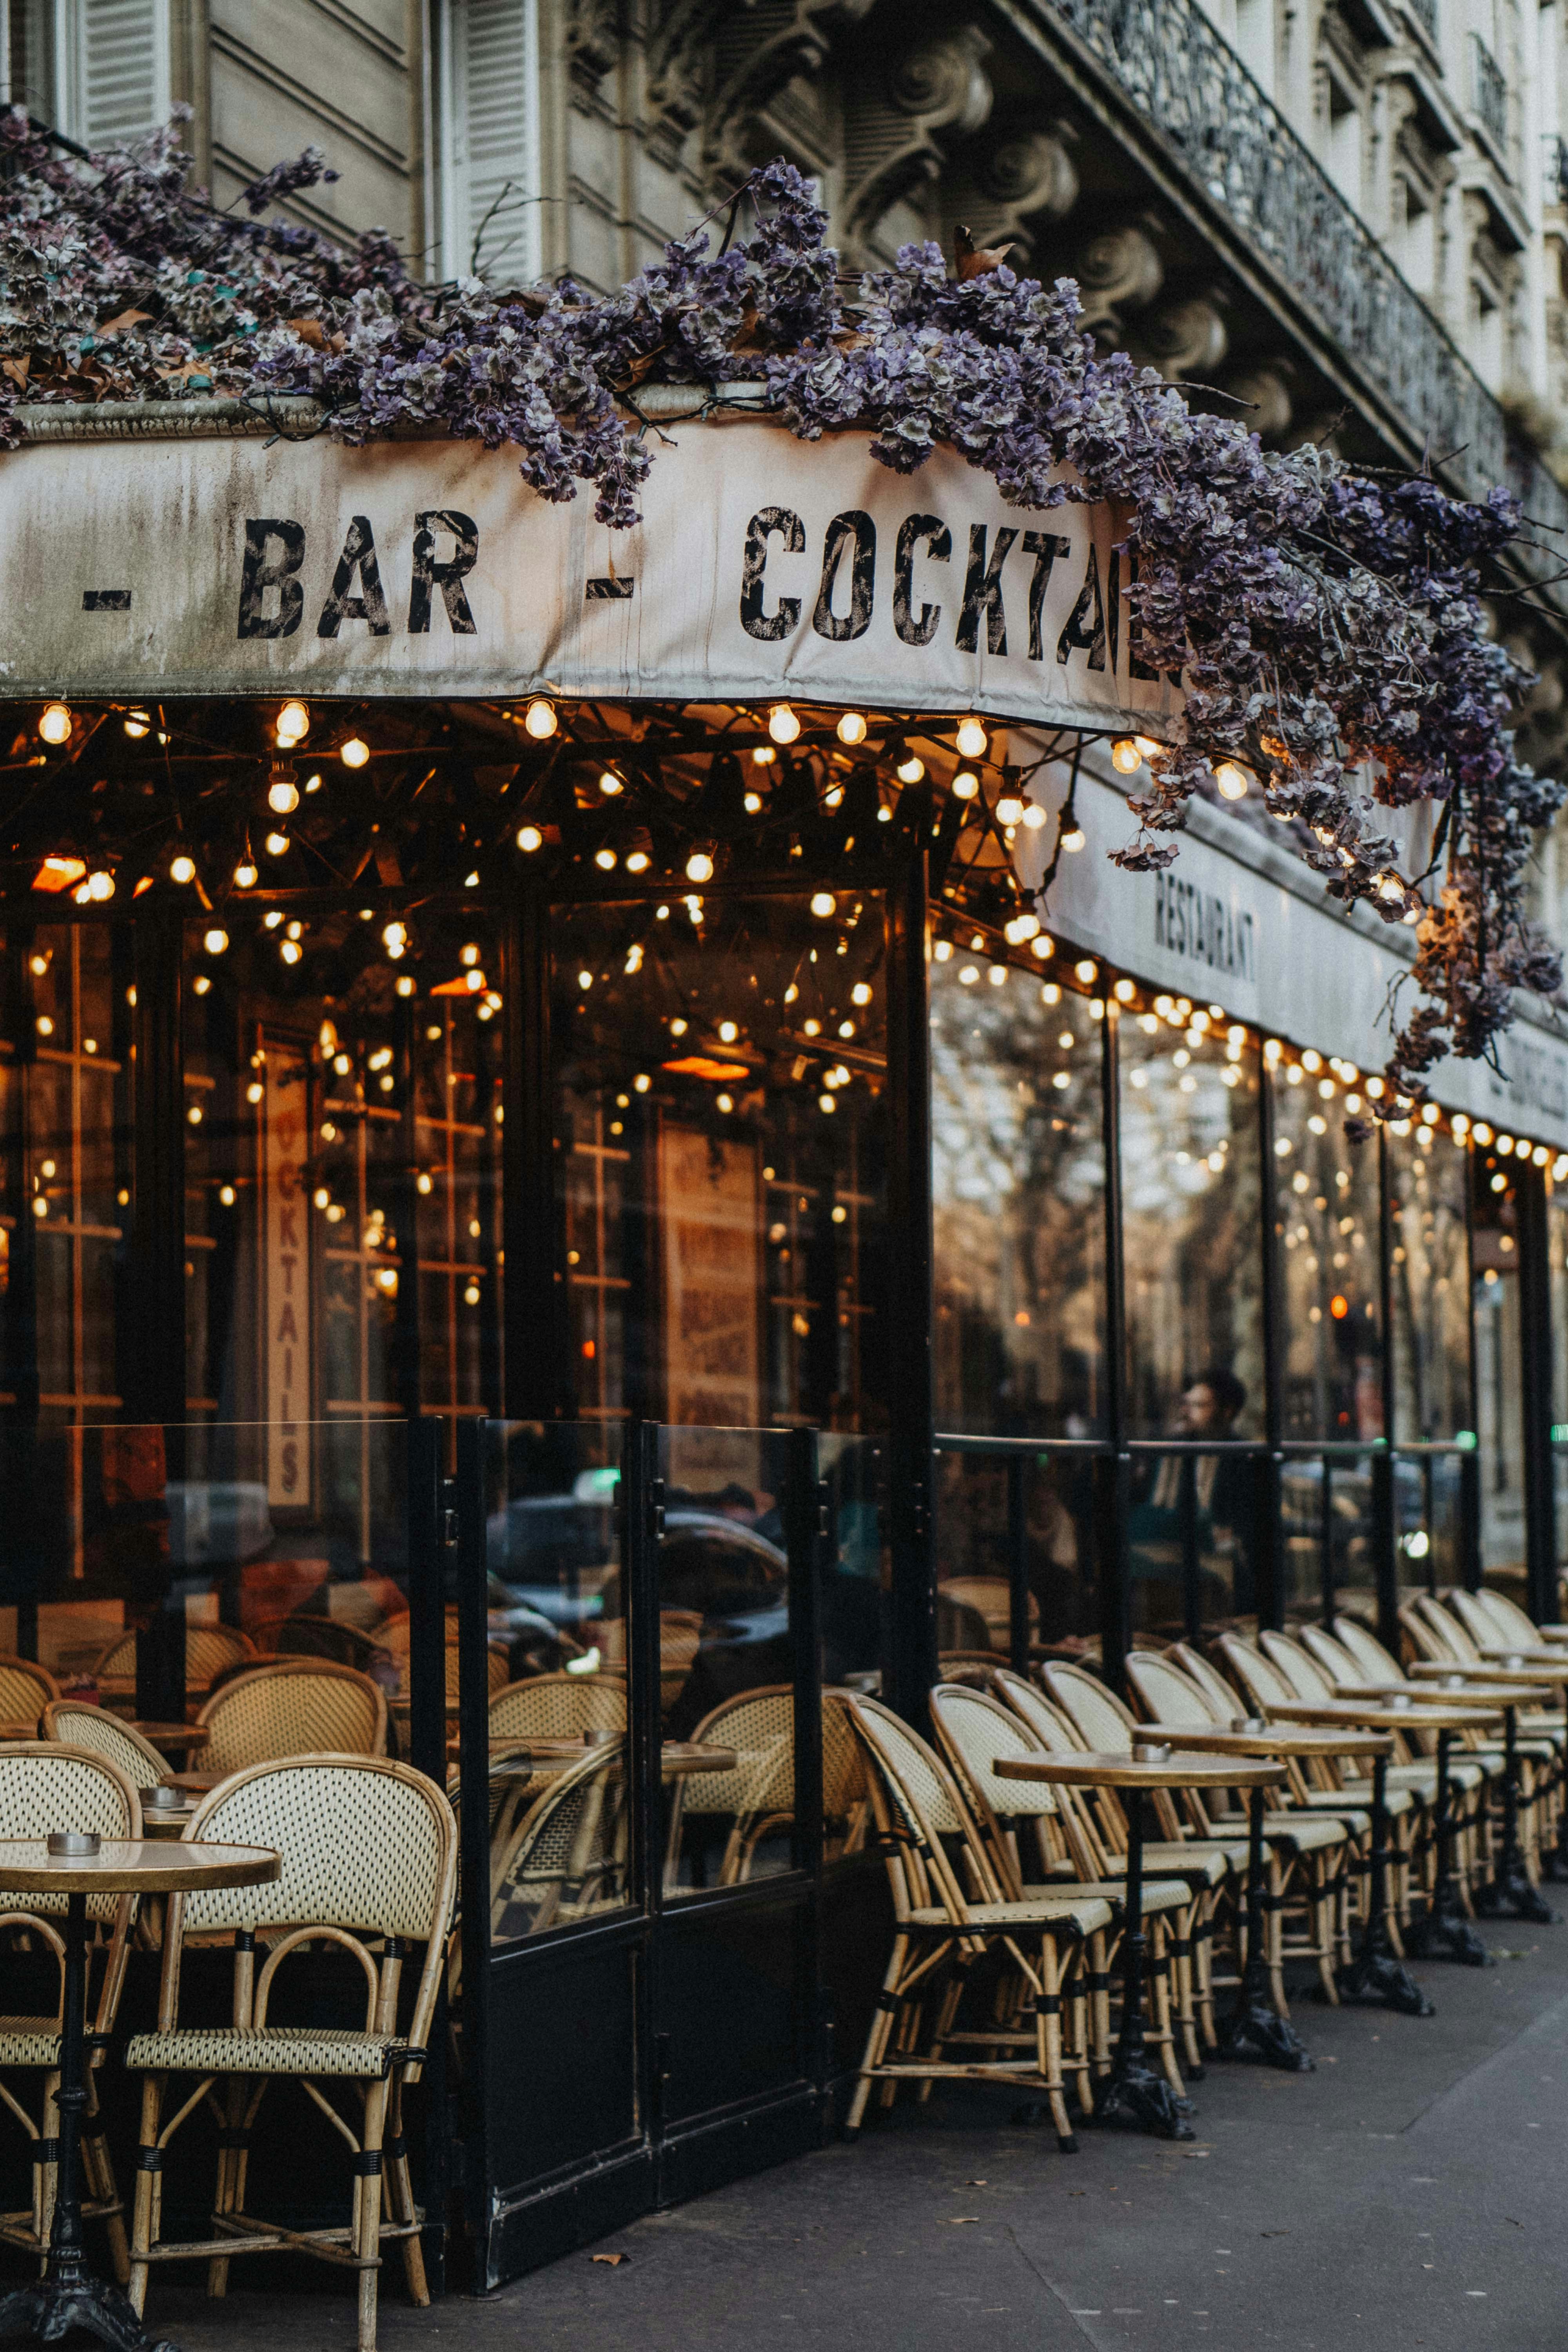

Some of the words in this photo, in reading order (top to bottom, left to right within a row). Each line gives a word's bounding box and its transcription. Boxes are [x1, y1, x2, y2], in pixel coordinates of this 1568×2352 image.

[237, 510, 479, 639] BAR
[740, 506, 1187, 689] COCKTAIL
[276, 1066, 300, 1493] OCKTAILS
